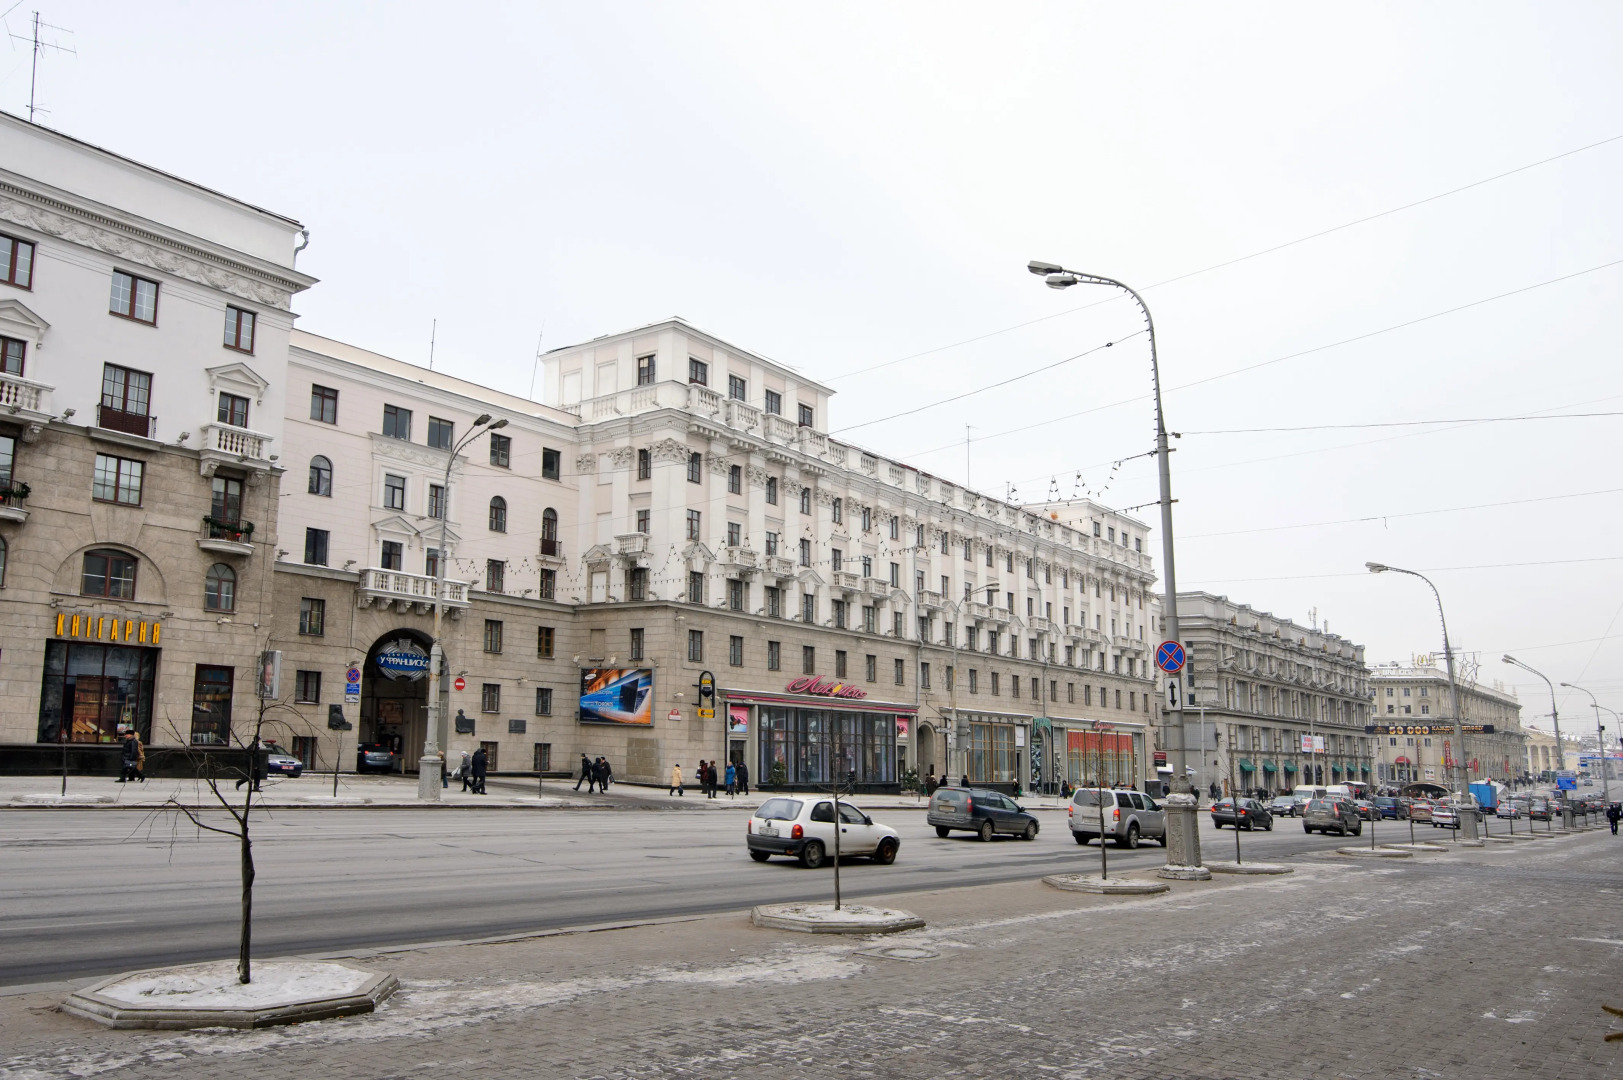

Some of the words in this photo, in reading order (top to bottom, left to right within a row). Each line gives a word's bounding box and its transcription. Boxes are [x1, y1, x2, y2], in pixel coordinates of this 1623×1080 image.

[56, 613, 160, 644] КНІГАРНЯ
[1389, 726, 1404, 735] 50
[1406, 726, 1429, 735] 000
